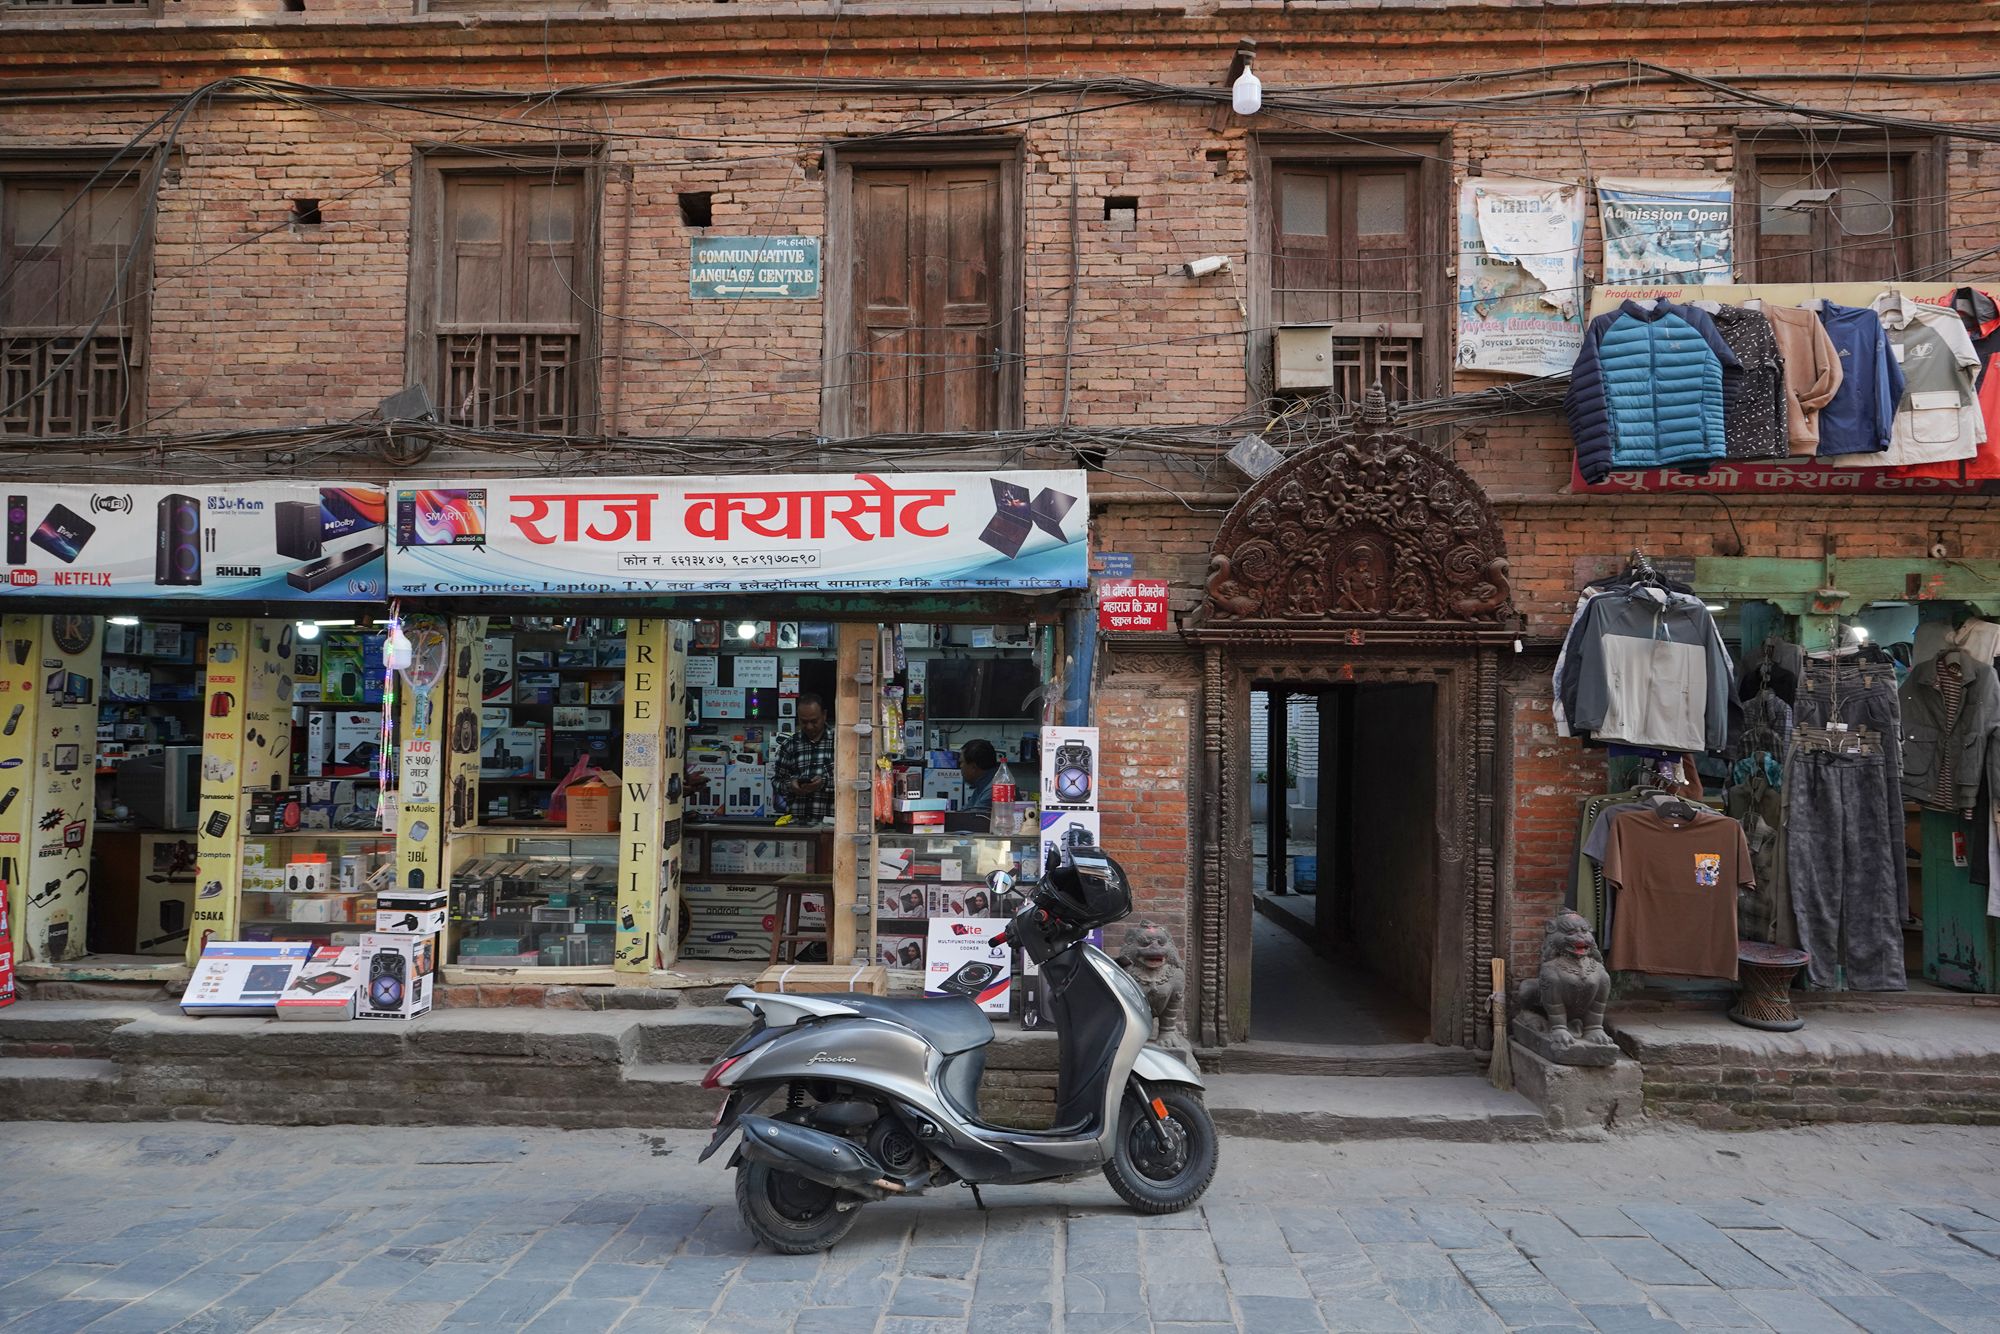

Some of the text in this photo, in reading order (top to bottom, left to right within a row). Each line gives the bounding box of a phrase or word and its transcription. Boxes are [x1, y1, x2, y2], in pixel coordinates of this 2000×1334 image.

[1604, 206, 1728, 223] Admission Open
[699, 249, 805, 264] COMMUNICATIVE
[1474, 255, 1488, 266] To
[692, 268, 814, 283] LANGUAGE CENTRE
[1605, 289, 1682, 298] Product of Nepal
[1481, 339, 1513, 349] Jaycees
[1516, 337, 1556, 349] Secondary
[1558, 339, 1583, 349] School
[1754, 467, 1864, 488] फेशन
[218, 496, 264, 509] Su-Kam
[509, 473, 956, 544] राज क्यासेट
[425, 512, 459, 520] SMART
[335, 518, 356, 528] Dolby
[624, 553, 816, 567] फोन नं. ६६१३५४७, ९८४९१७०८९०
[216, 567, 261, 577] AHUJA
[54, 571, 112, 587] NETFLIX
[402, 582, 427, 592] यहाँ
[434, 582, 535, 593] Computer,
[543, 581, 616, 594] Laptop,
[623, 581, 658, 591] T.V
[667, 582, 694, 591] तथा
[703, 582, 731, 591] अन्य
[941, 579, 969, 587] तथा
[1101, 583, 1110, 597] श्री
[1103, 601, 1130, 613] महाराज
[1132, 599, 1142, 613] कि
[1144, 602, 1158, 613] जय
[217, 622, 232, 631] CG
[251, 712, 269, 721] Music
[408, 741, 432, 753] JUG
[405, 755, 413, 766] रु
[626, 619, 655, 892] FREE WIFI
[410, 768, 429, 778] मात्र
[411, 804, 436, 812] Music
[68, 830, 79, 839] TV
[39, 849, 62, 858] REPAIR
[408, 851, 427, 862] JBL
[194, 911, 224, 921] OSAKA
[706, 906, 739, 915] android
[955, 925, 982, 935] Kite
[615, 950, 627, 959] 5G
[728, 946, 756, 955] Pioneer
